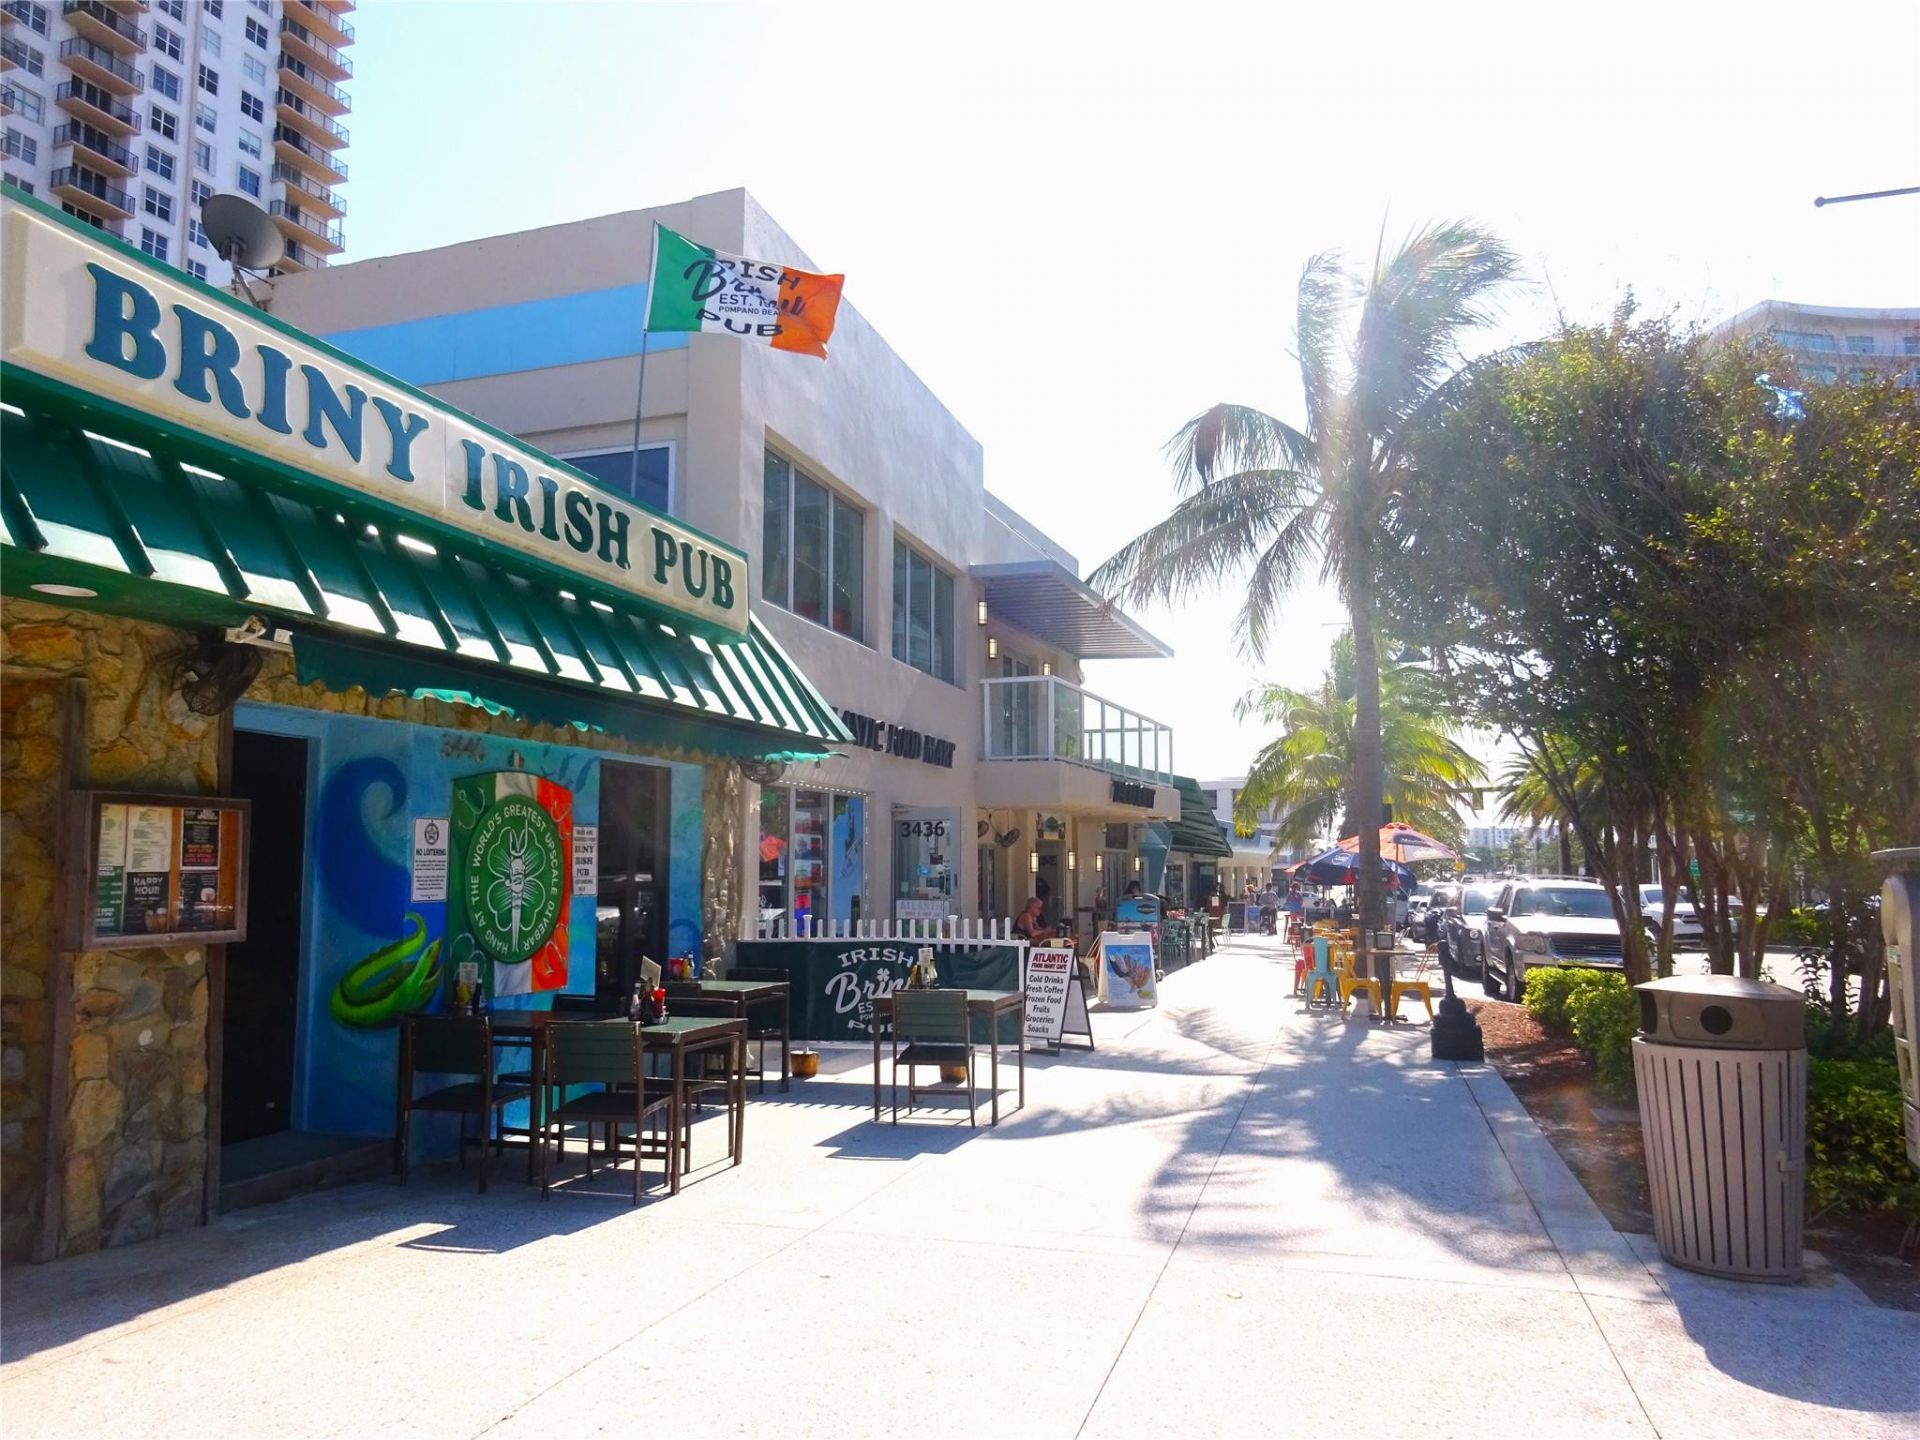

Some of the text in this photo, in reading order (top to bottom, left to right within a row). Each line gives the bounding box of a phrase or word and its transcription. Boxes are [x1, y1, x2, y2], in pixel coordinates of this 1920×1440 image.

[719, 293, 753, 307] EST.
[718, 306, 759, 315] POMPANO
[695, 308, 784, 337] PUB
[85, 262, 736, 610] BRINY IRISH PUB
[901, 821, 945, 838] 3436
[133, 877, 163, 887] HAPPY
[471, 804, 559, 955] HANG AT THE WORLD'S GREATEST UPSCALE DIVEBAR
[134, 886, 160, 895] HOUR
[837, 947, 914, 968] IRISH
[1033, 953, 1068, 963] ATLANTIC
[1029, 974, 1064, 984] Cold Drinks
[824, 971, 912, 1014] Brin
[1025, 984, 1064, 994] Fresh Coffee
[1025, 994, 1062, 1004] Frozen Food
[857, 1001, 874, 1014] ES
[1033, 1005, 1050, 1013] Fruits
[1025, 1014, 1055, 1024] Groceries
[1027, 1025, 1049, 1033] Snacks
